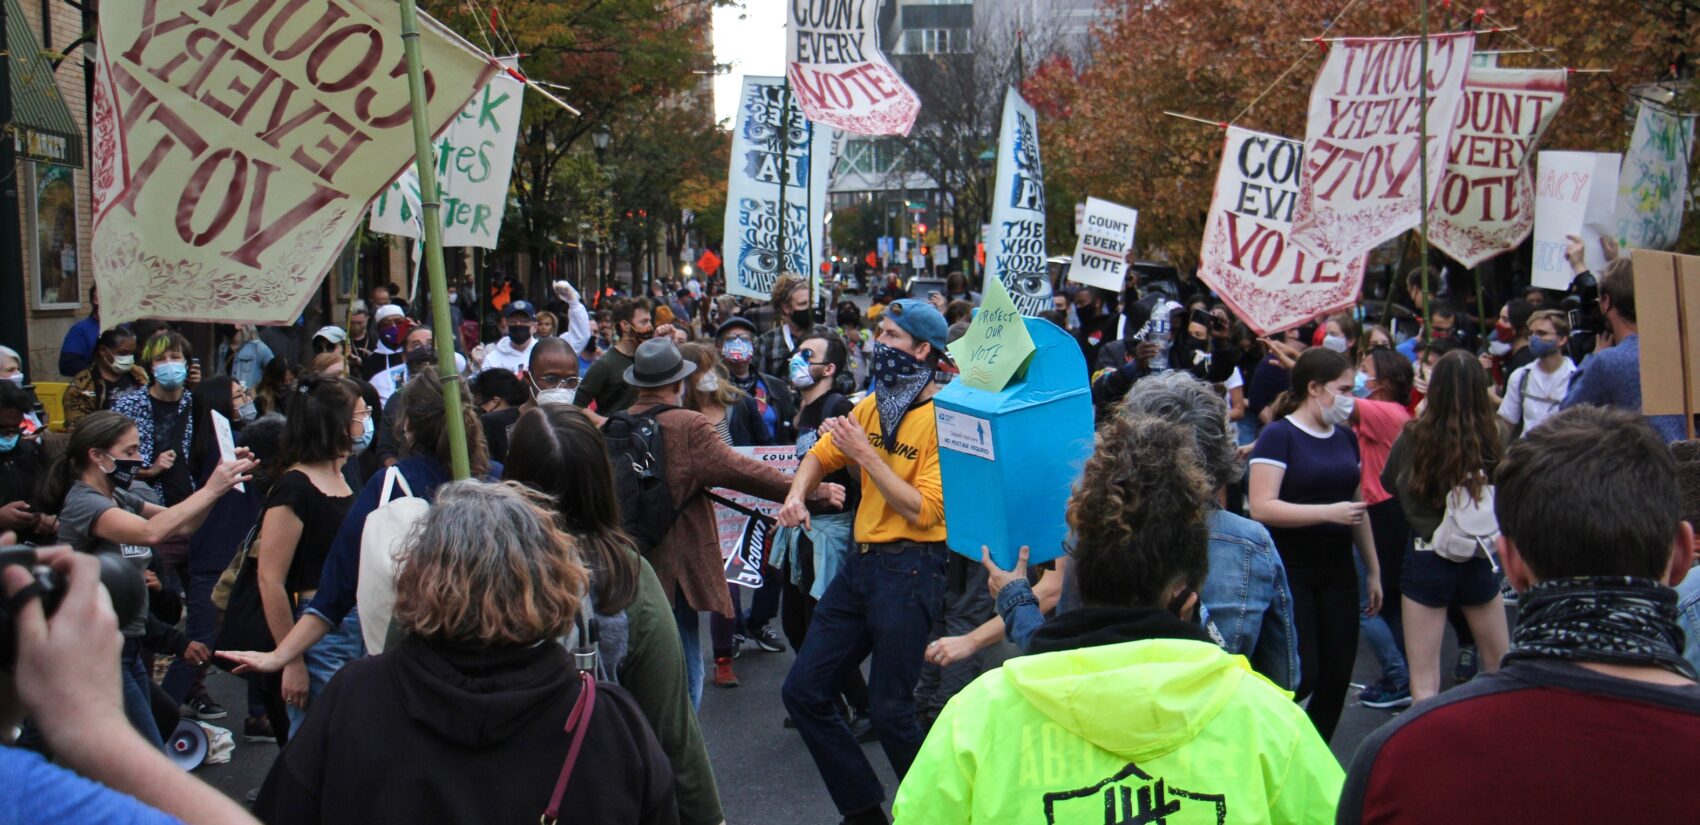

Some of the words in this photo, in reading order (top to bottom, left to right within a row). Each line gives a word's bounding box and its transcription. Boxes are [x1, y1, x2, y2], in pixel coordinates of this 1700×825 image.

[797, 30, 867, 64] EVERY
[791, 62, 898, 109] VOTE
[1003, 221, 1043, 239] THE
[1088, 215, 1128, 233] COUNT
[1083, 234, 1125, 252] EVERY
[1081, 253, 1121, 274] VOTE
[978, 307, 1016, 325] PROTECT
[985, 325, 1003, 338] OUR
[971, 343, 1003, 364] VOTE
